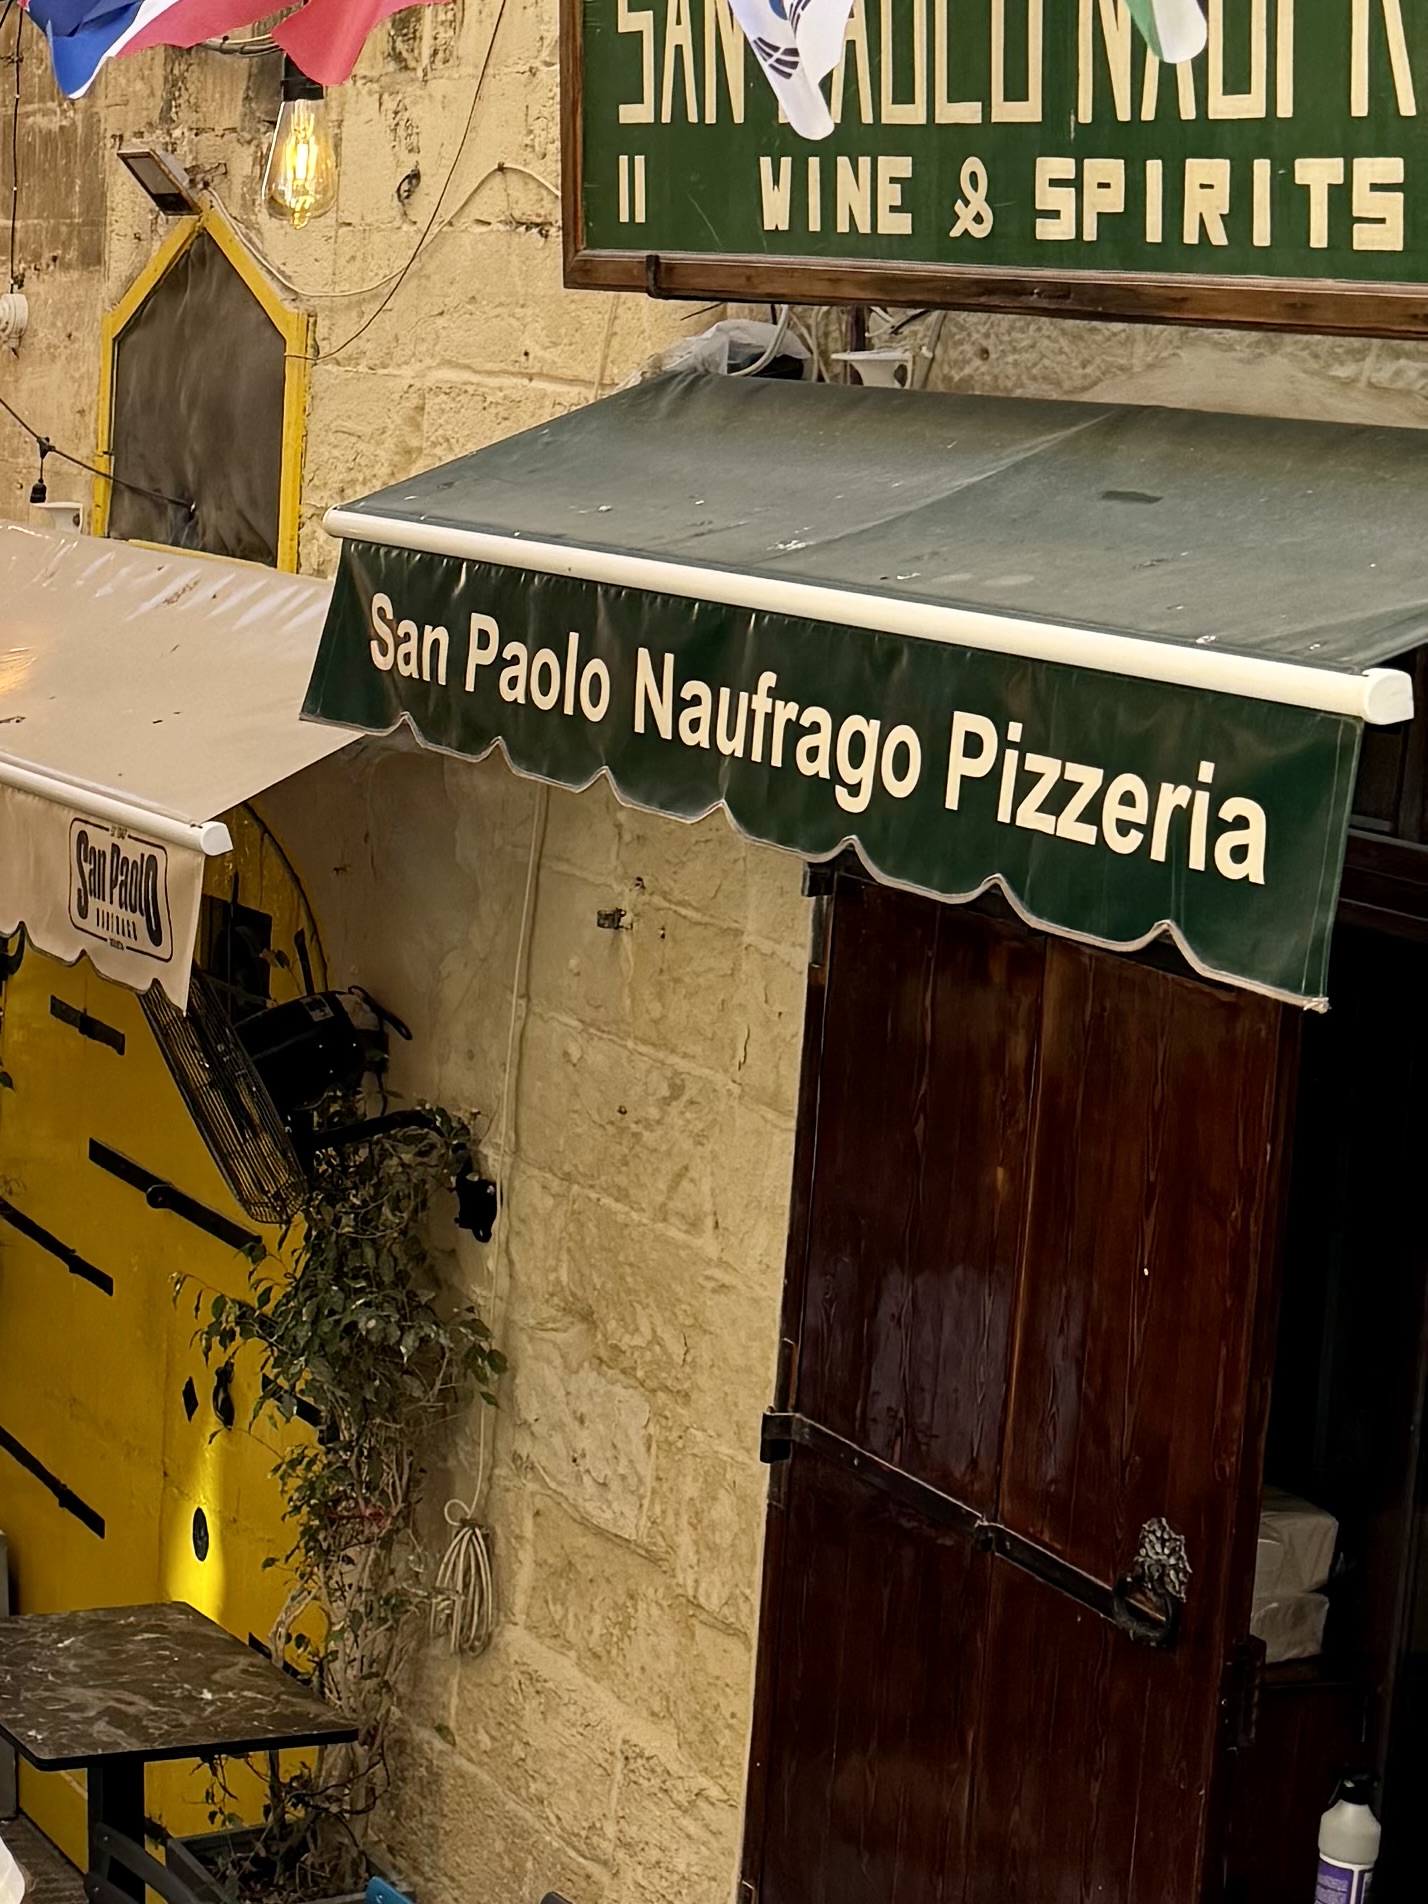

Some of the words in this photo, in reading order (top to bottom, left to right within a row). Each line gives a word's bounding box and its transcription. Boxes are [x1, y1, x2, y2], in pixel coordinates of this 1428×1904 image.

[759, 155, 913, 235] WINE
[950, 156, 993, 239] &
[1035, 156, 1405, 251] SPIRITS
[369, 593, 448, 685] San
[464, 612, 609, 722] Paolo
[633, 647, 922, 813] Naufrago
[944, 710, 1267, 885] Pizzeria
[77, 830, 106, 919] San
